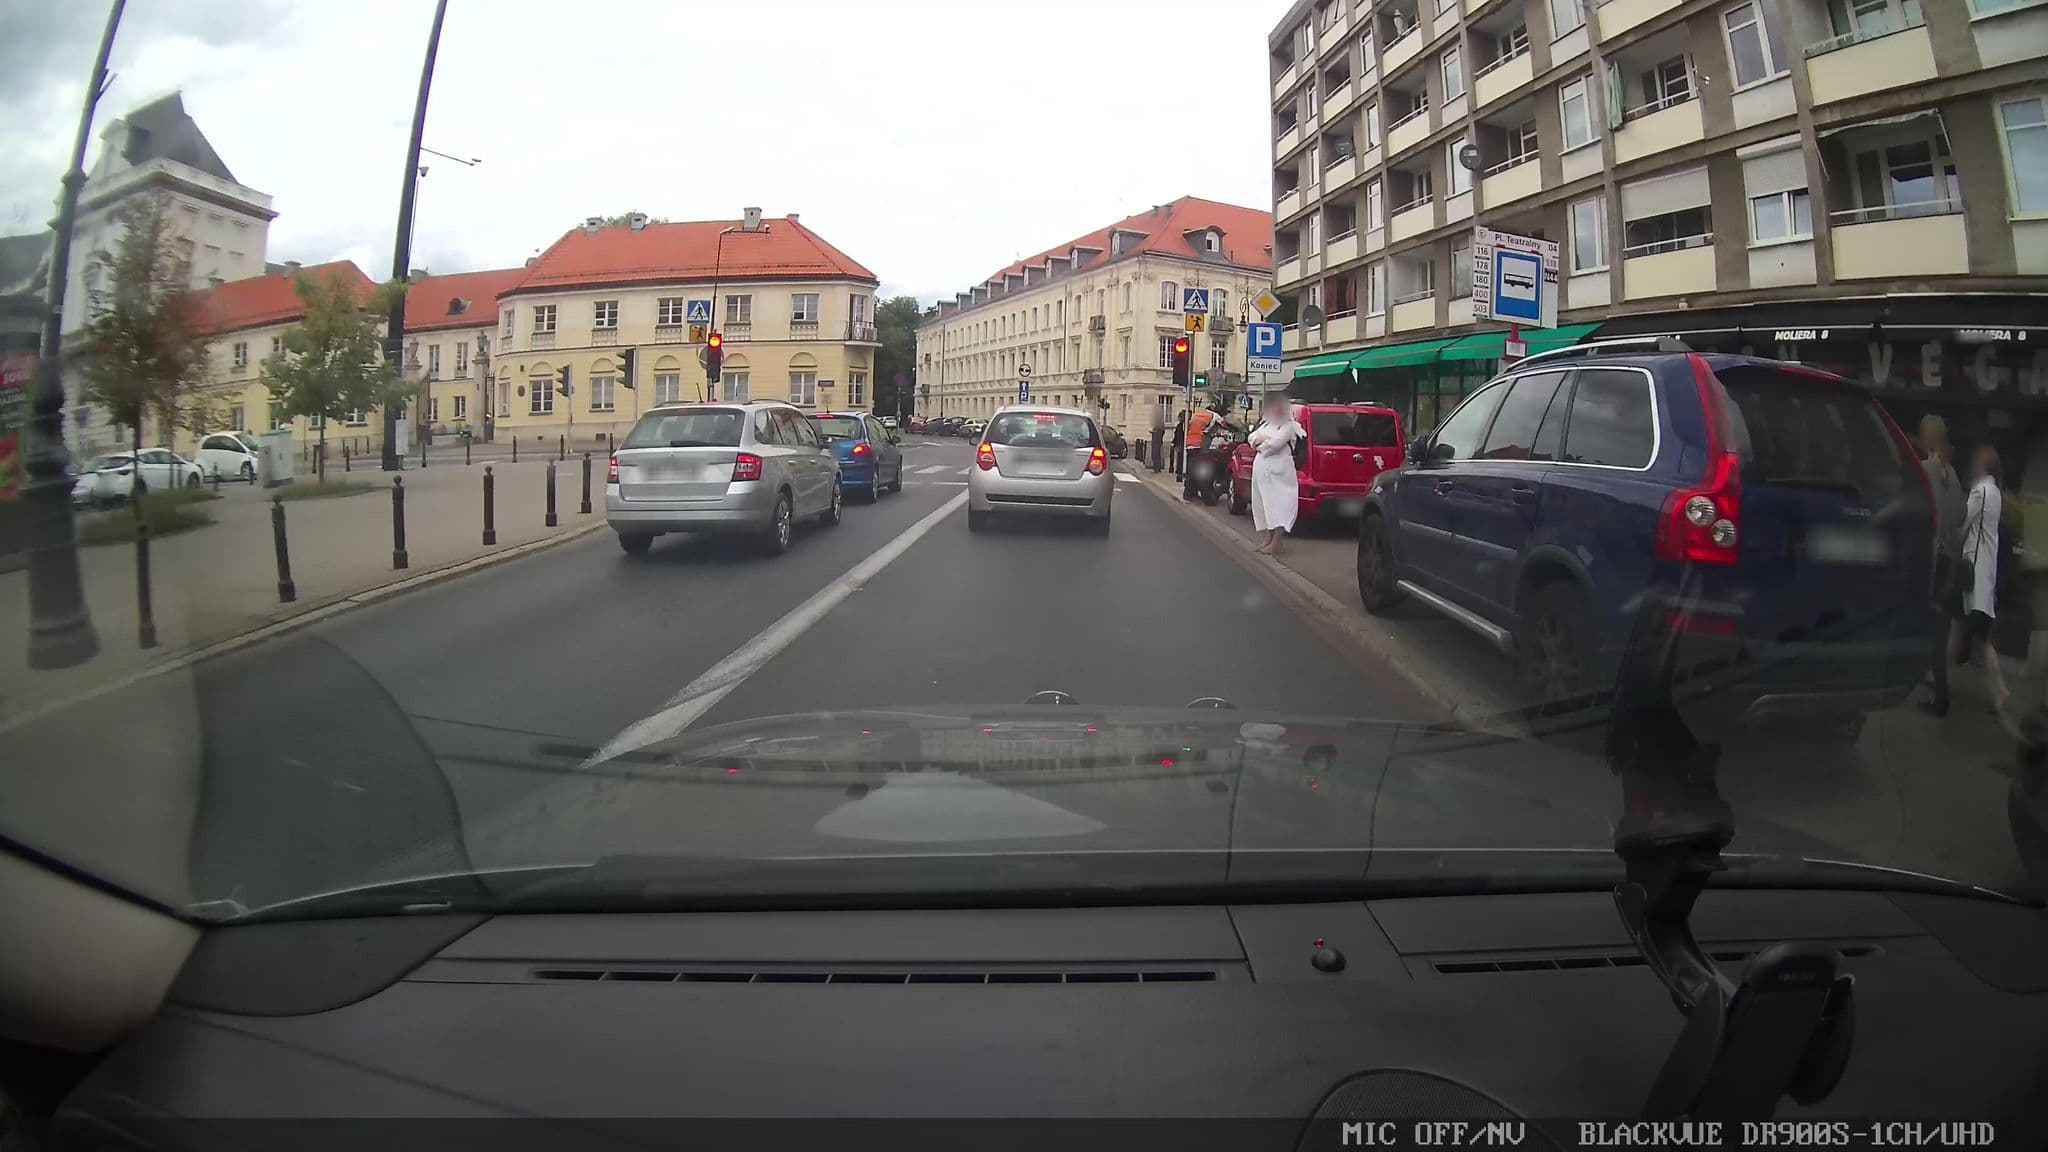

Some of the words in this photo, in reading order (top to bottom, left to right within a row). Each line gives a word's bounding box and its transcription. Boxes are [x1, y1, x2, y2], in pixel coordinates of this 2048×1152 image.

[1495, 233, 1503, 243] Pl.
[1506, 235, 1541, 249] Teatralny
[1477, 246, 1488, 256] 116
[1548, 244, 1558, 252] 04
[1476, 261, 1489, 270] 178
[1476, 275, 1488, 284] 180
[1474, 289, 1488, 298] 400
[1473, 304, 1487, 313] 503
[1775, 330, 1816, 340] MOLIERA
[1821, 330, 1829, 339] 8
[1256, 327, 1275, 353] P
[1250, 361, 1278, 370] Koniec
